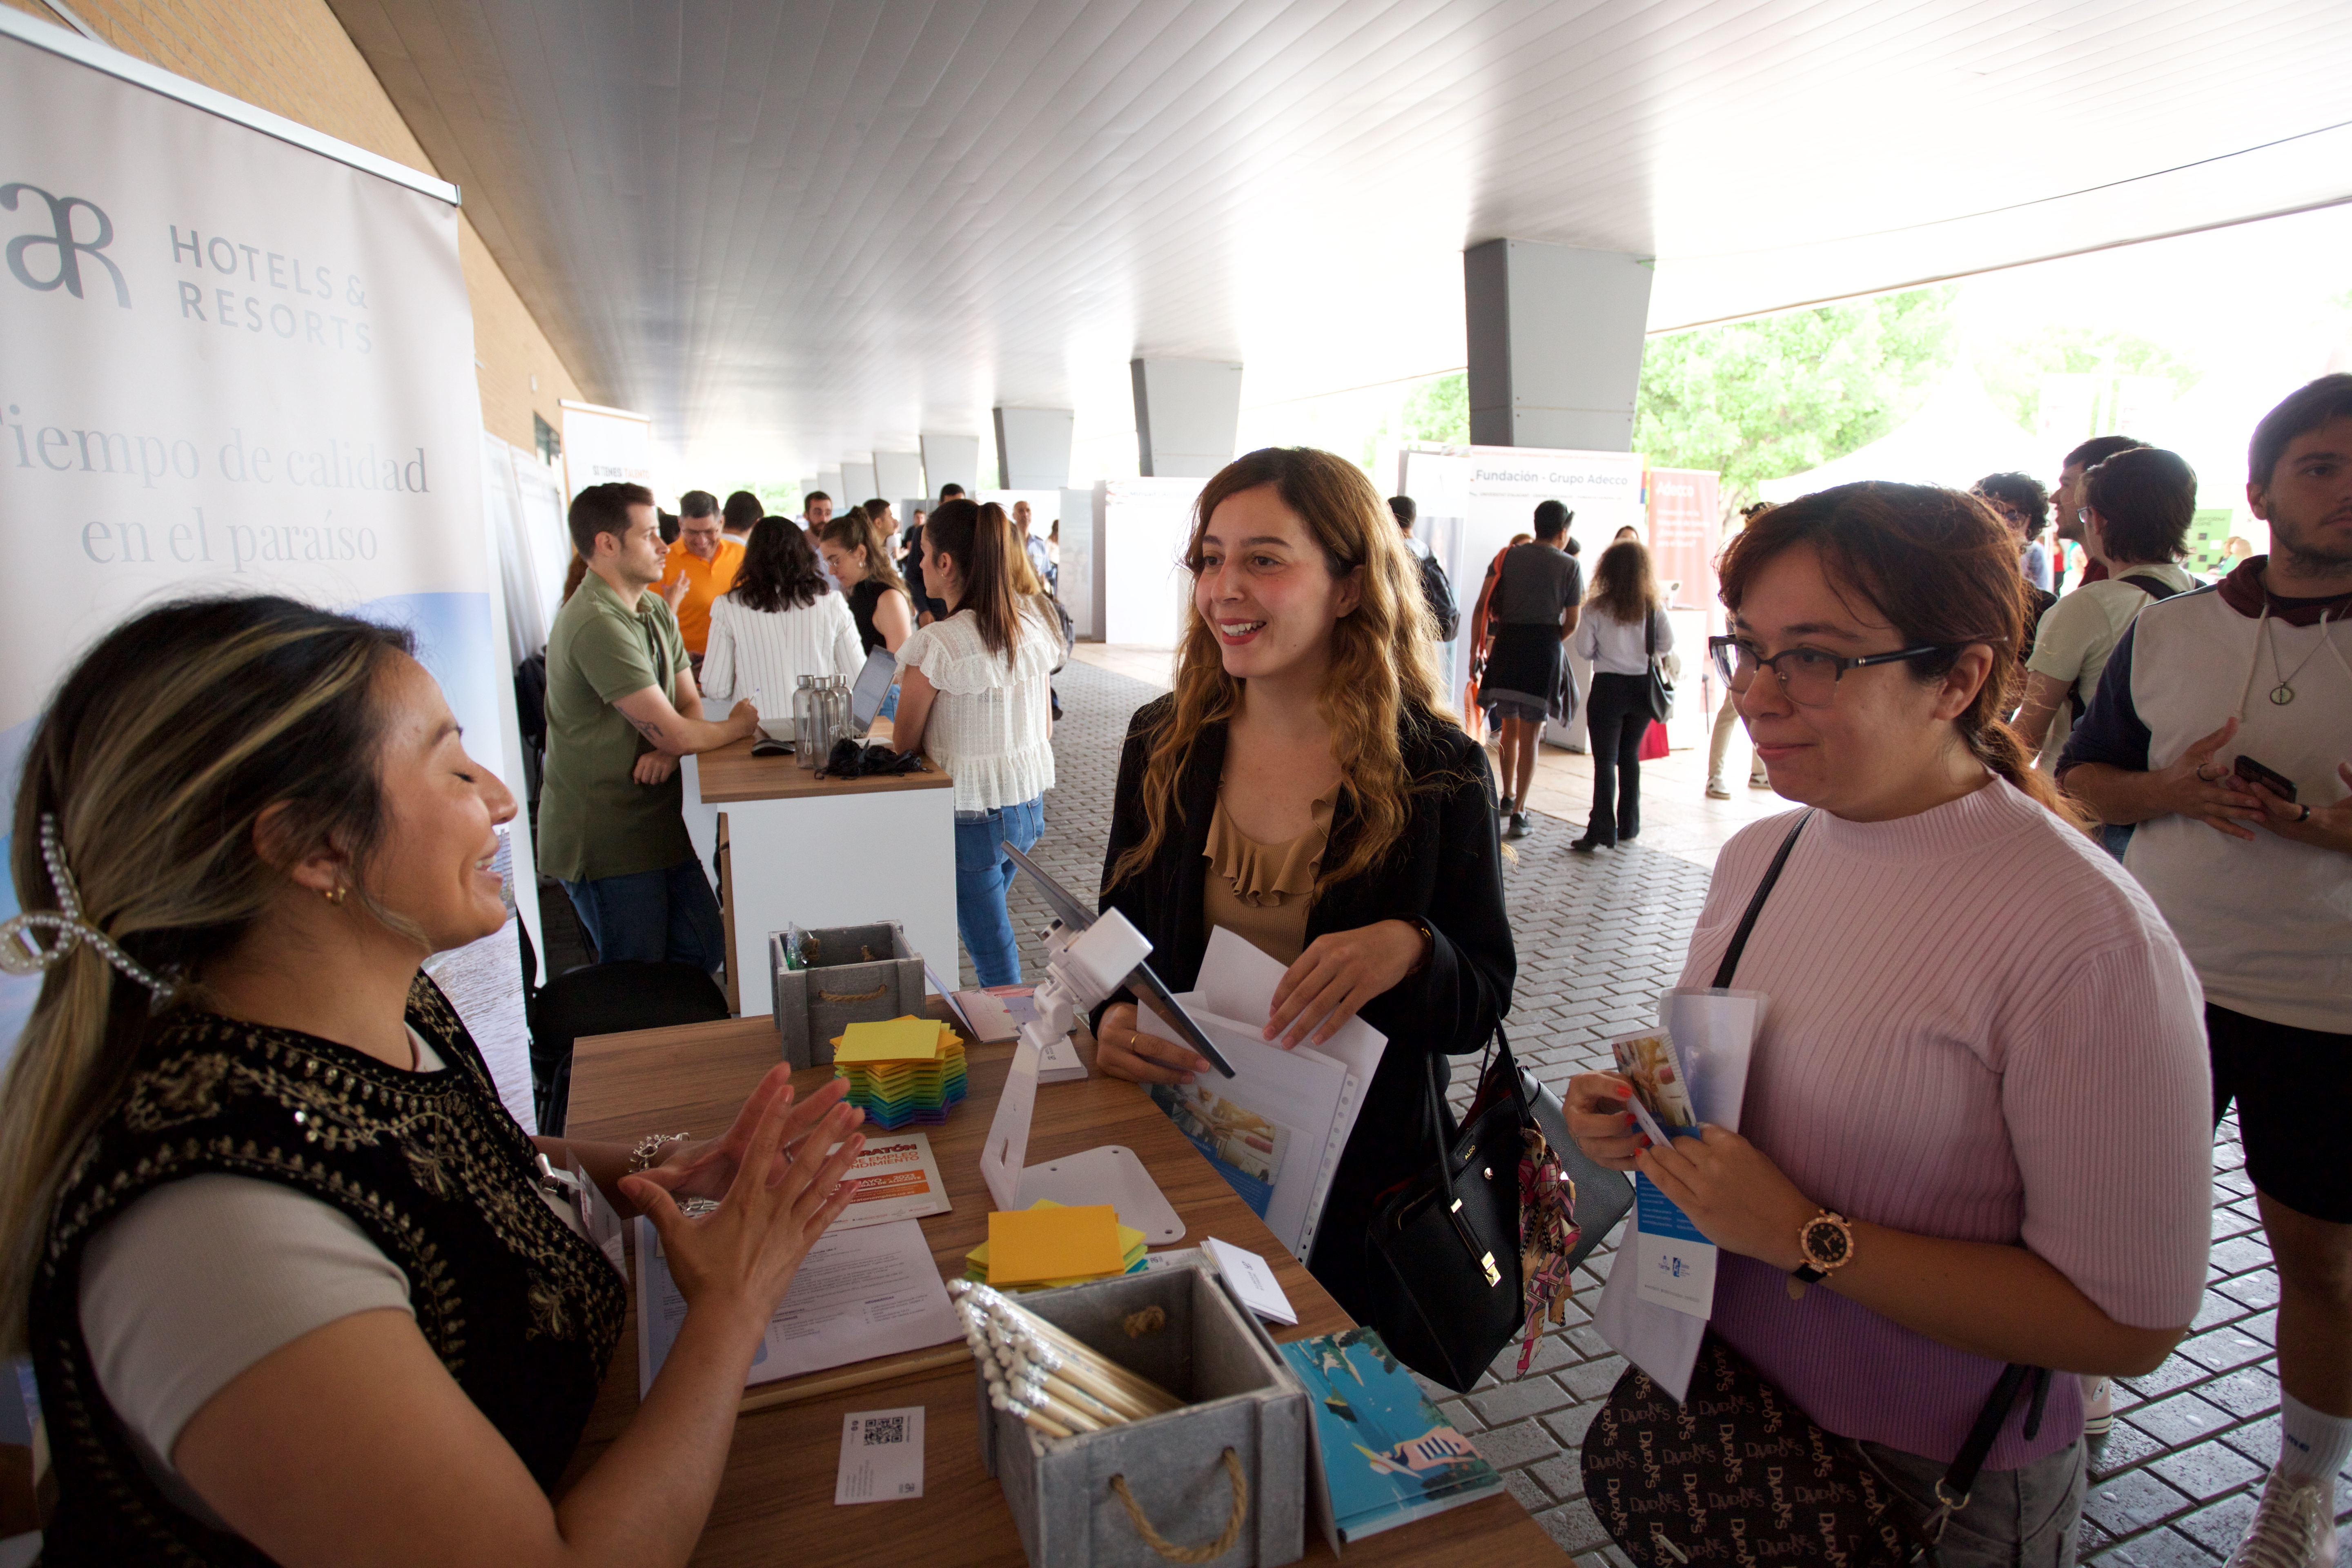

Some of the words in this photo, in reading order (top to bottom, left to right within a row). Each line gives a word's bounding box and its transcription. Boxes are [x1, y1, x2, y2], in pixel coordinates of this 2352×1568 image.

[169, 225, 333, 300] HOTELS
[346, 274, 368, 309] &
[178, 280, 372, 354] RESORTS
[0, 405, 200, 488] iempo
[219, 428, 274, 484] de
[287, 439, 430, 493] calidad
[624, 468, 650, 479] TALENTO
[1476, 470, 1539, 483] Fundación
[1549, 472, 1584, 486] Grupo
[1588, 474, 1628, 486] Adecco
[1655, 480, 1694, 497] Adecco
[81, 519, 155, 564] en
[168, 507, 214, 562] el
[227, 510, 378, 573] paraíso
[858, 1144, 917, 1157] RATÓN
[869, 1151, 918, 1162] EMPLEO
[1465, 1145, 1476, 1160] ALDO
[851, 1156, 920, 1169] NDIMIENTO
